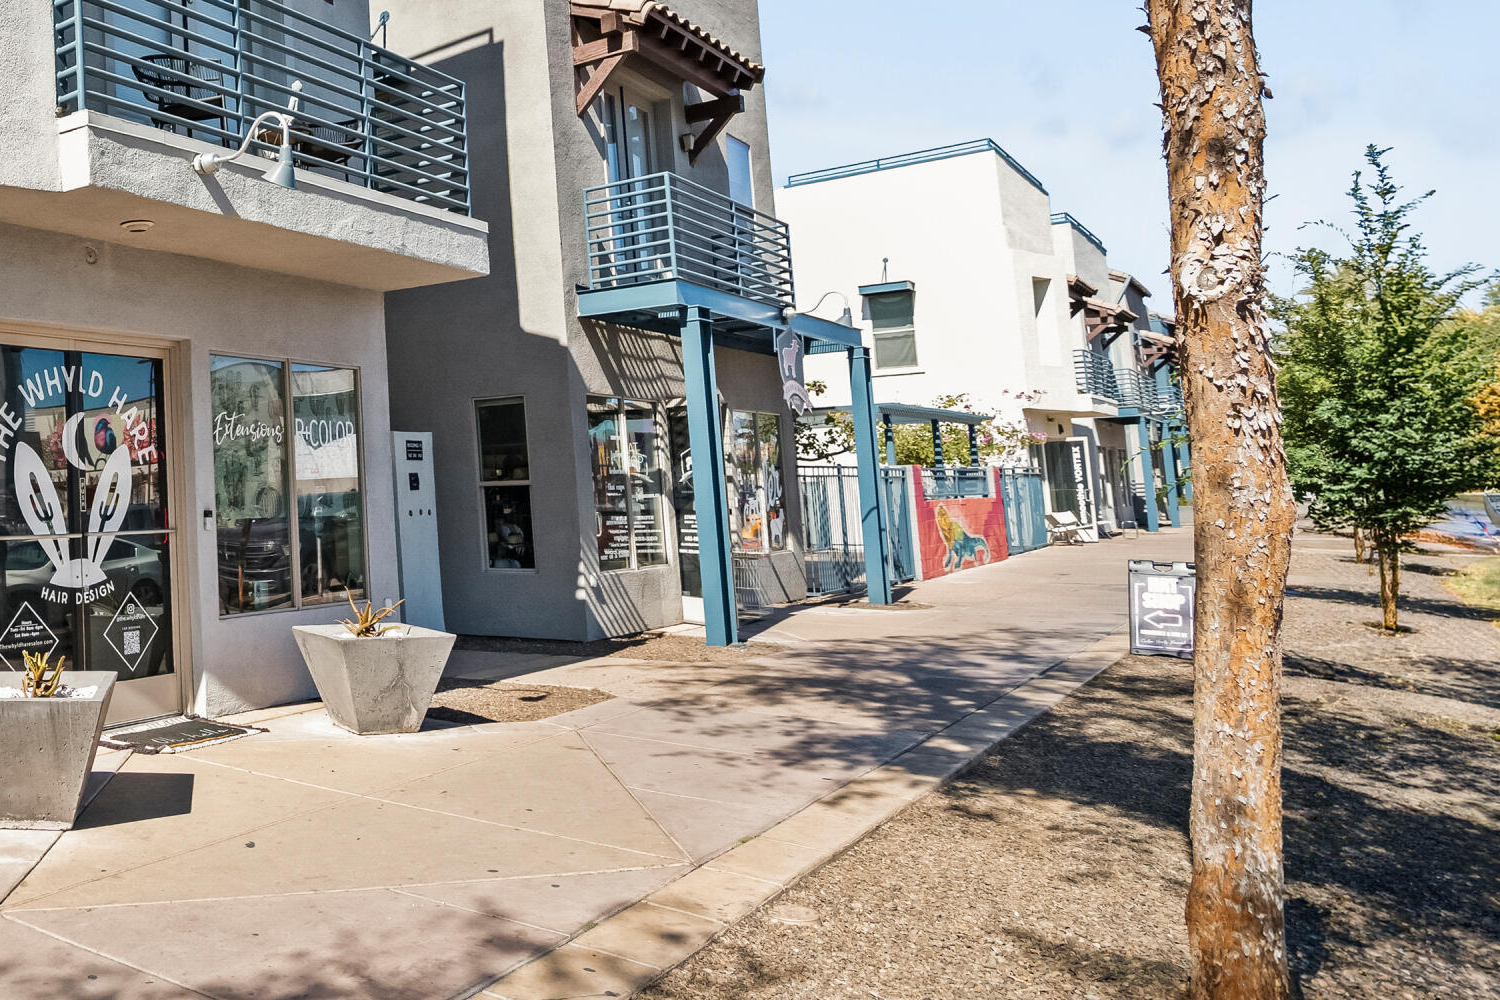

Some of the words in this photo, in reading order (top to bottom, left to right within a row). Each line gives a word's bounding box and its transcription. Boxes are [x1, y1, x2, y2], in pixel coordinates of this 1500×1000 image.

[18, 366, 104, 407] WHYLD
[108, 386, 157, 464] HARE
[213, 411, 285, 446] Extensions
[295, 417, 355, 448] R+COLOR
[41, 586, 68, 604] HAIR
[75, 580, 115, 605] DESIGN
